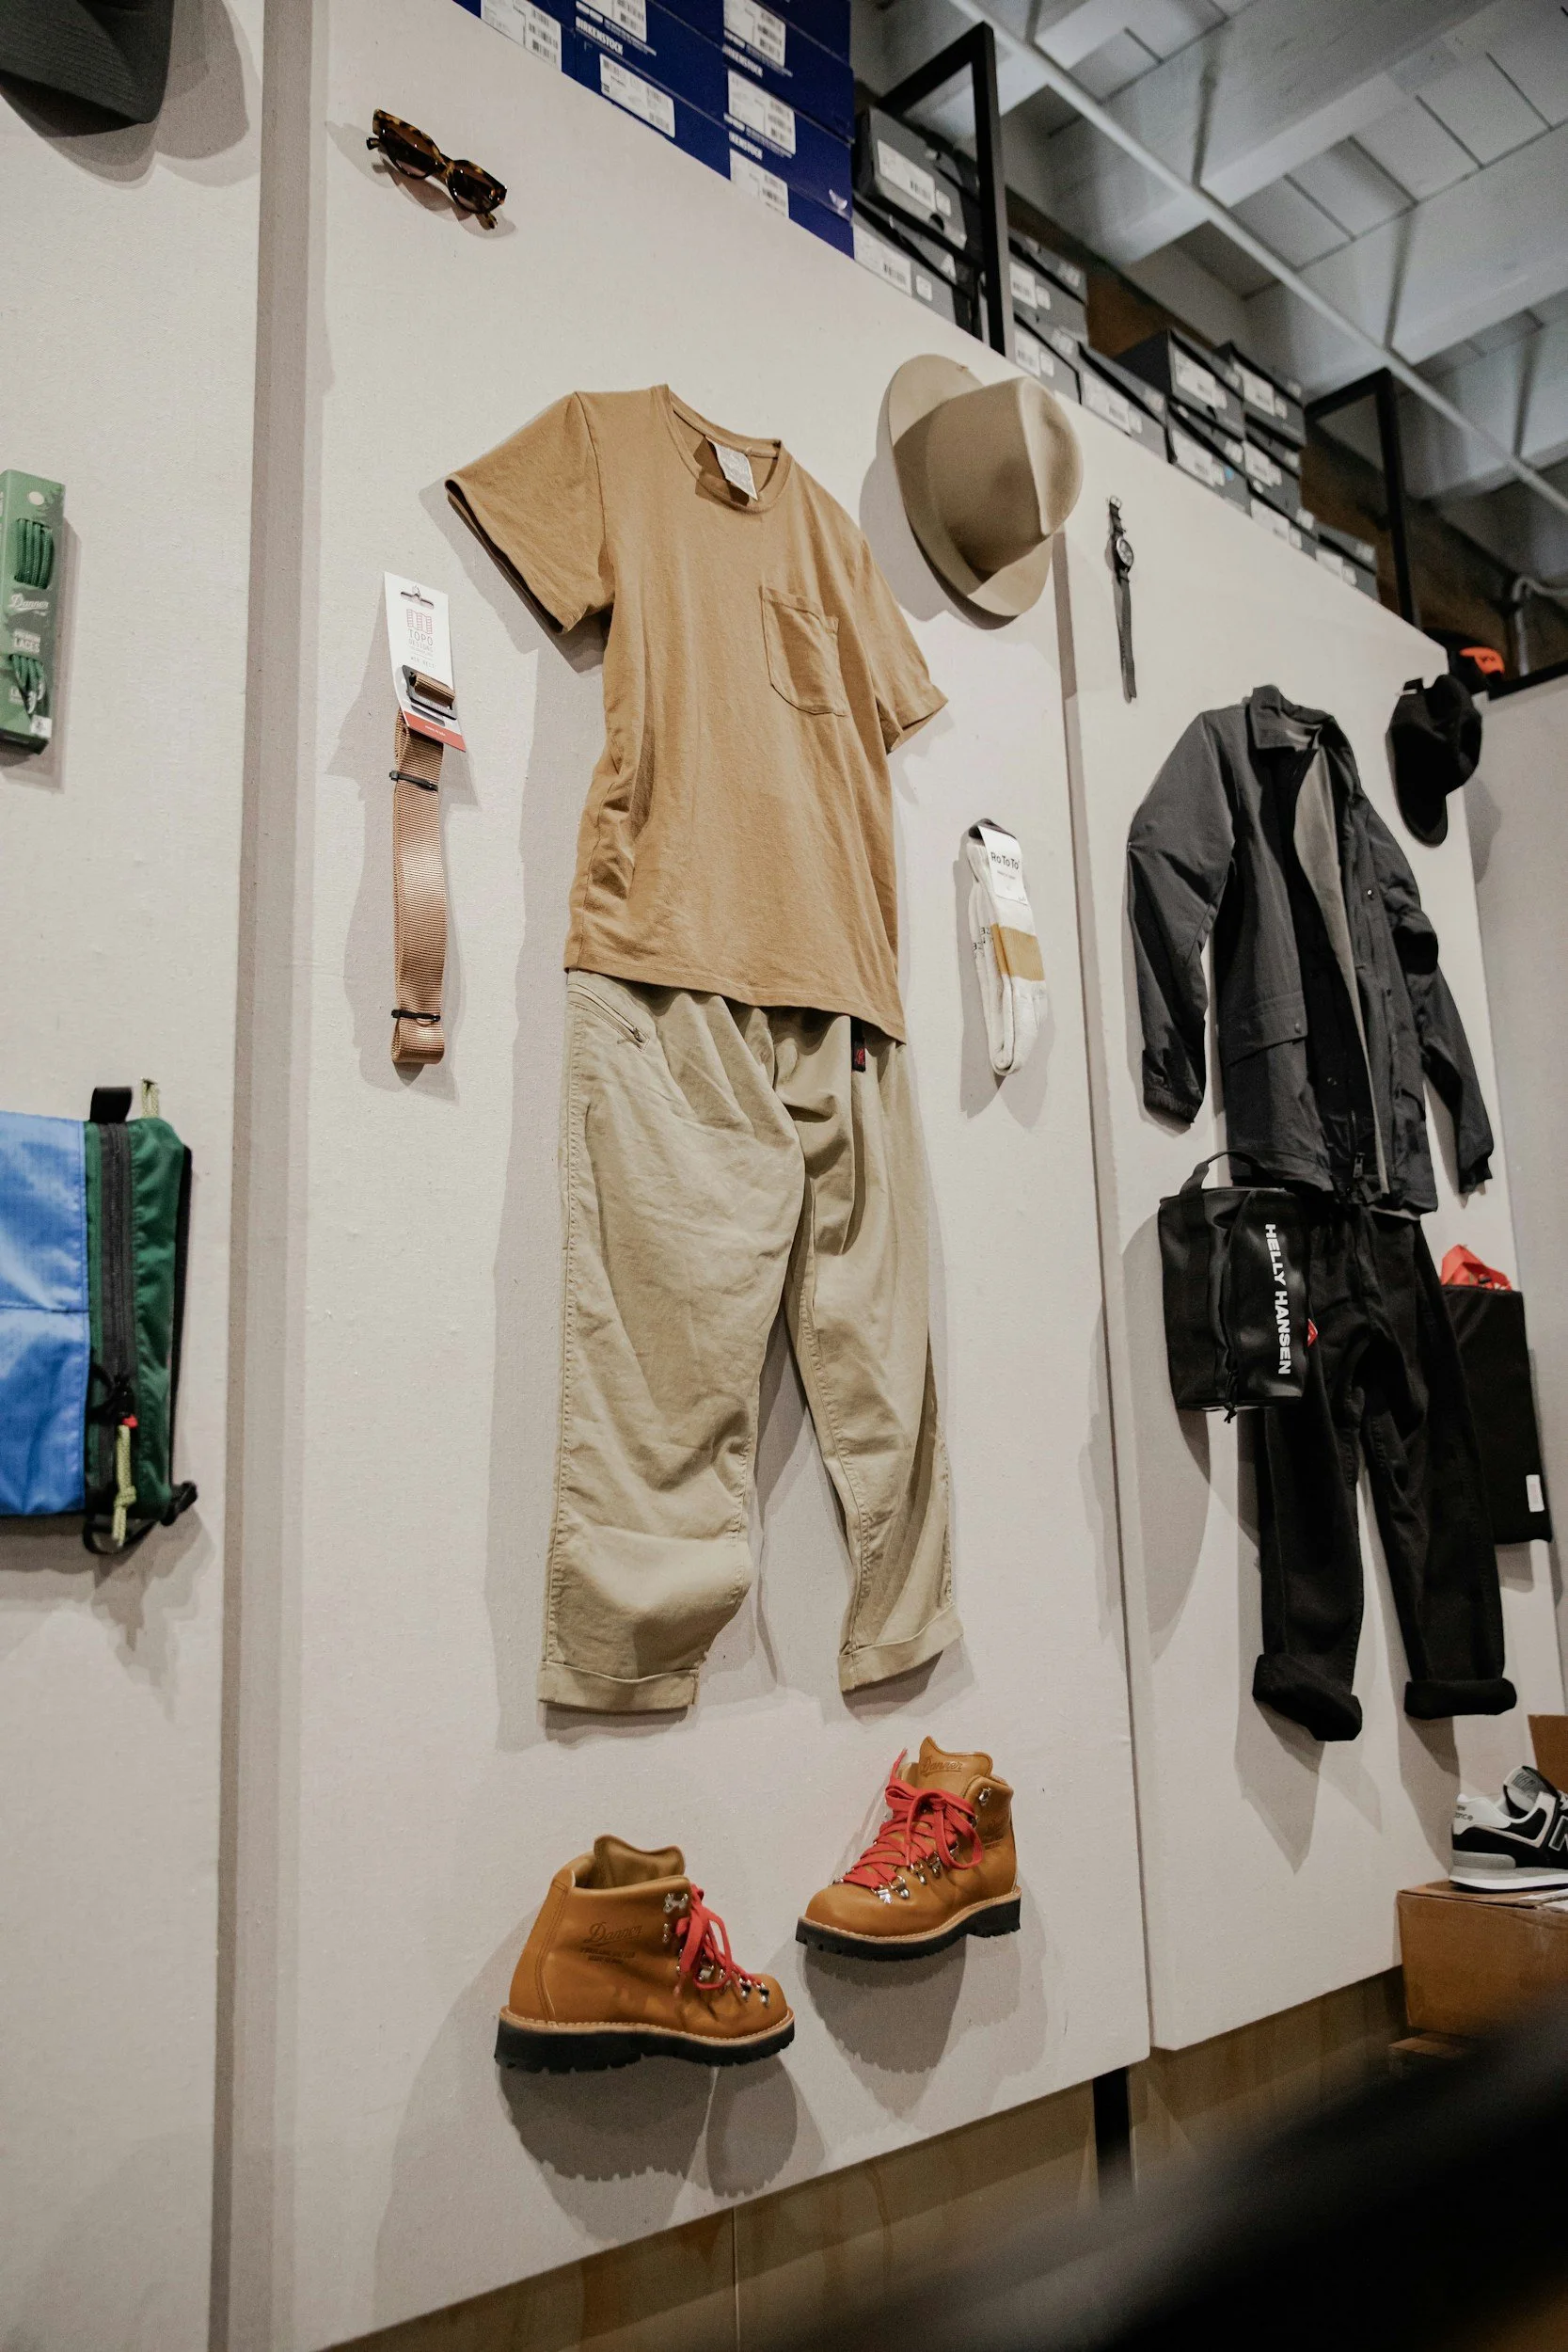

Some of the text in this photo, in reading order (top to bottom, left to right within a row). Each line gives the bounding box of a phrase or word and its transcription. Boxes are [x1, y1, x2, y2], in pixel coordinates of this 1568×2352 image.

[8, 593, 49, 612] Danner
[408, 628, 433, 645] TOPO
[1265, 1224, 1291, 1375] HELLY HANSEN
[920, 1755, 963, 1777] Danner
[583, 1922, 643, 1947] Danner
